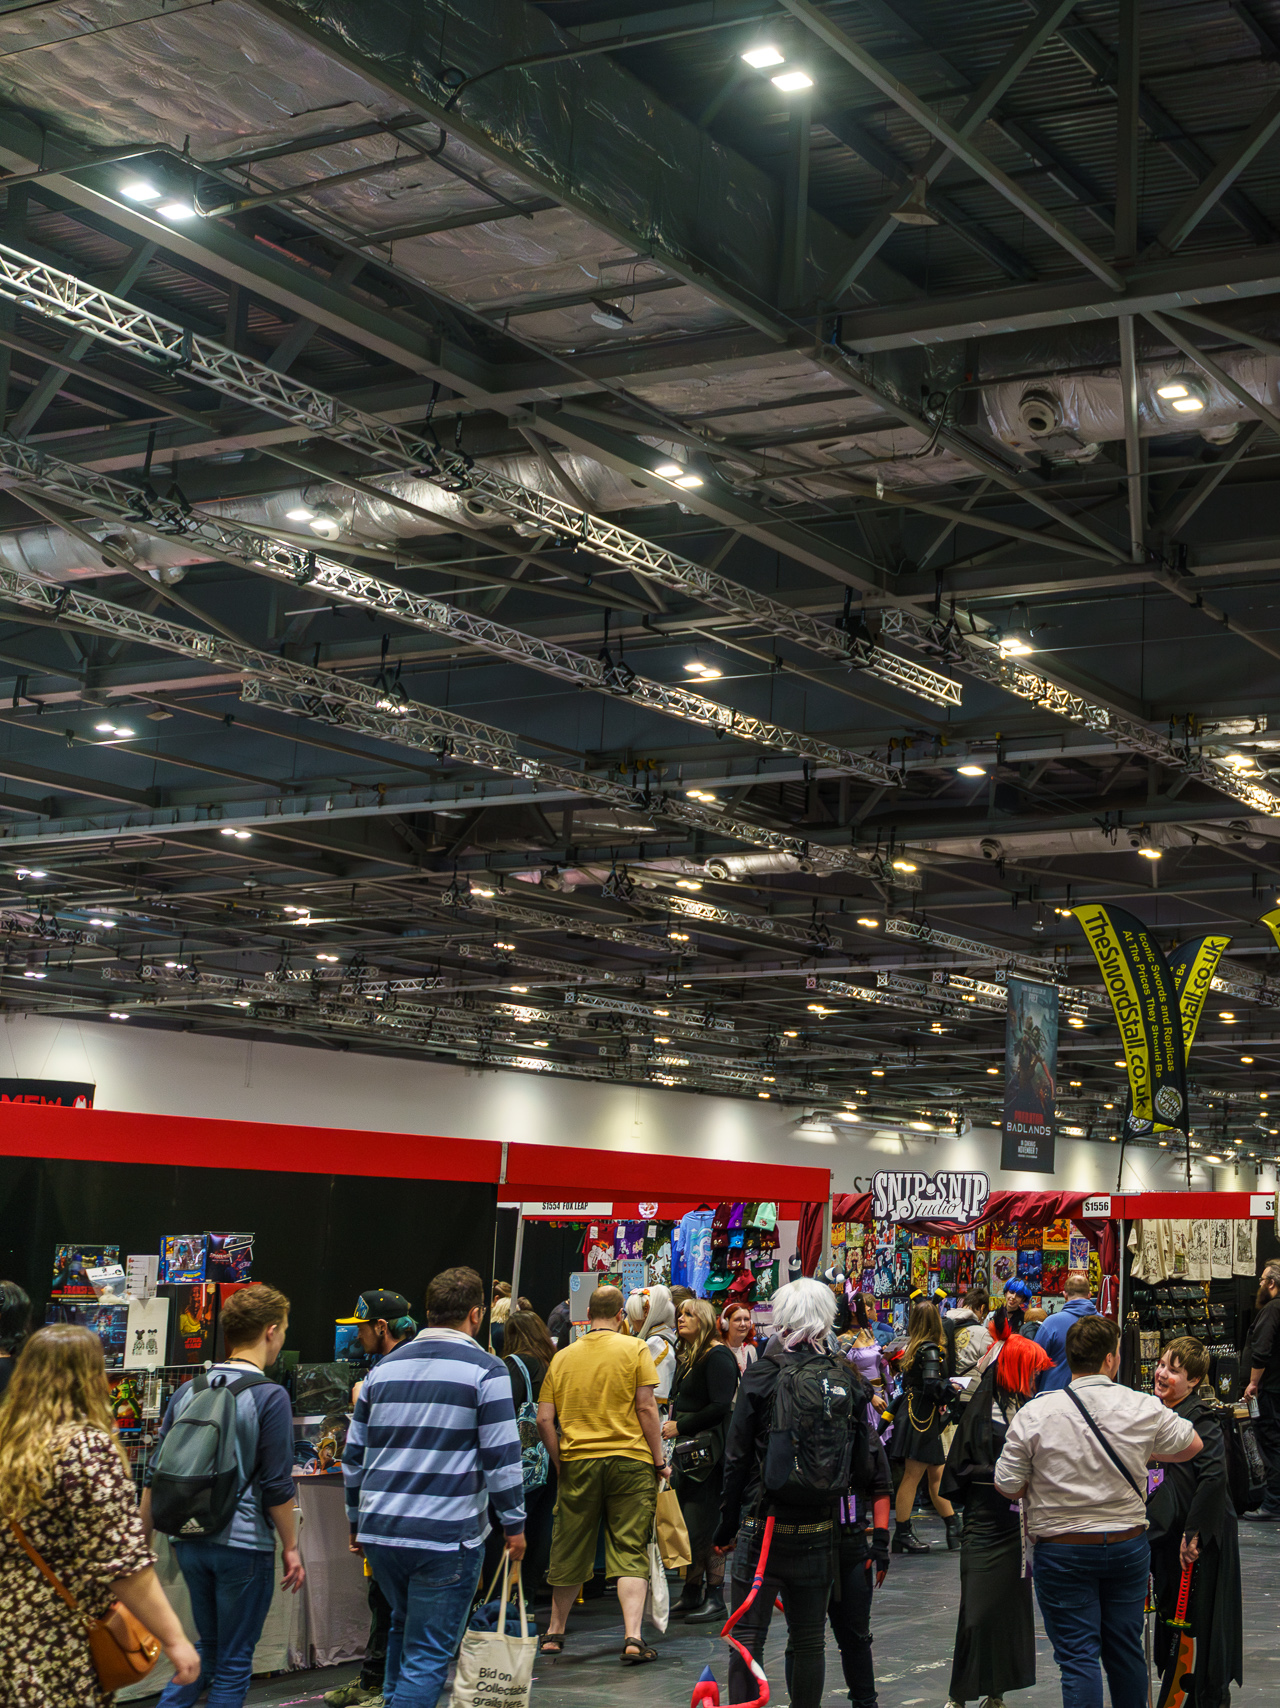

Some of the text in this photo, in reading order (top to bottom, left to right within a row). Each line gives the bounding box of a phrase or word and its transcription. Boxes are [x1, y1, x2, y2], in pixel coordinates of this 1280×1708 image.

[1122, 930, 1163, 1078] At The Prices They Should Be
[1138, 932, 1175, 1072] Iconic Swords and Replicas
[1085, 911, 1150, 1110] TheSwordStall.co.uk
[1006, 1121, 1052, 1136] BADLANDS
[874, 1172, 988, 1218] SNIP SNIP
[541, 1202, 589, 1210] S1554 FOX LEAP
[899, 1195, 961, 1221] Studio
[1084, 1201, 1109, 1212] S1556
[478, 1667, 512, 1682] Bid on
[476, 1681, 528, 1696] Collectable
[471, 1696, 525, 1708] grails here.
